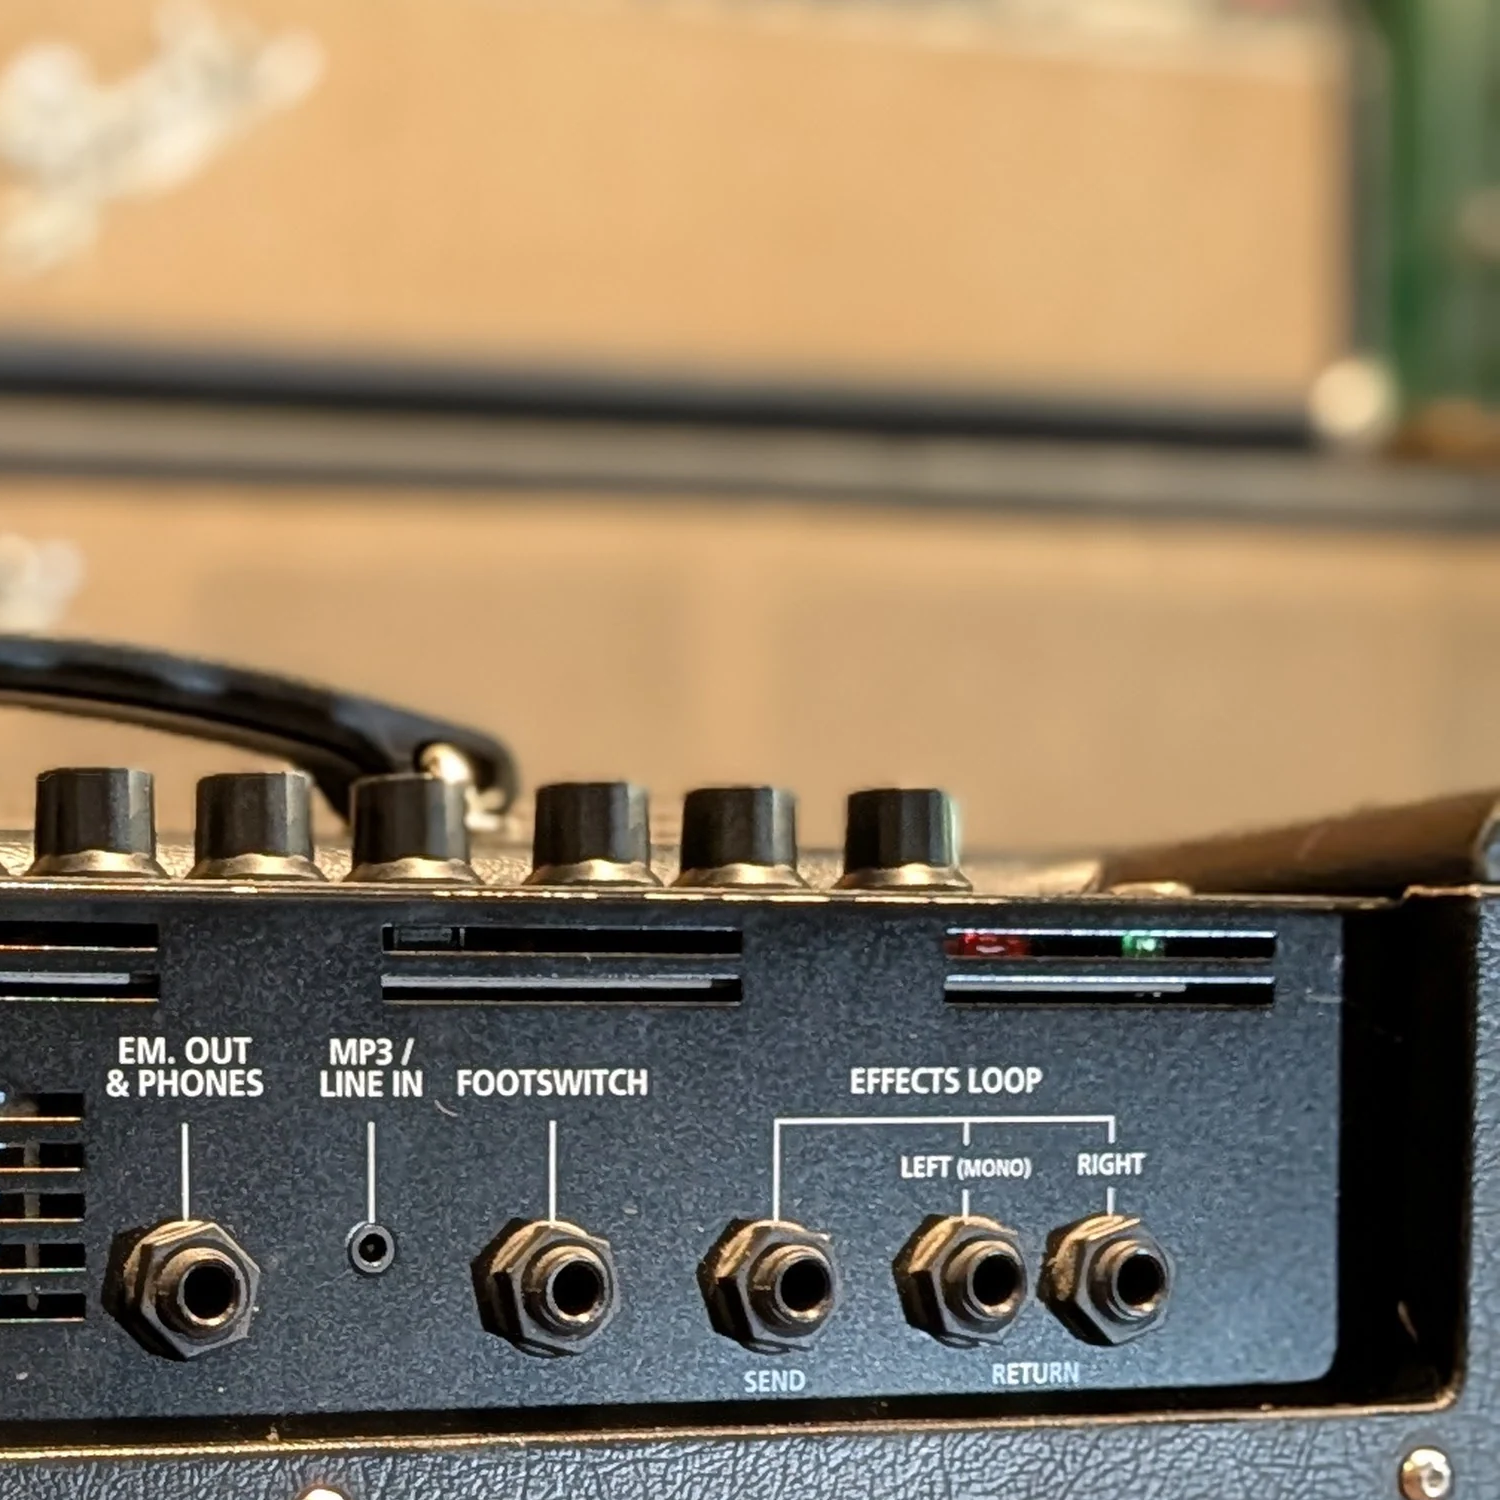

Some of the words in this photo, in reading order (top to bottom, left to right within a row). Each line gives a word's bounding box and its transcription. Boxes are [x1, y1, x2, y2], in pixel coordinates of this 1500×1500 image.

[117, 1037, 175, 1064] EM.
[185, 1036, 252, 1064] OUT
[329, 1038, 393, 1064] MP3
[402, 1037, 415, 1064] /
[105, 1071, 129, 1097] &
[138, 1069, 264, 1097] PHONES
[320, 1070, 383, 1098] LINE
[392, 1069, 423, 1097] IN
[456, 1069, 649, 1097] FOOTSWITCH
[850, 1067, 960, 1095] EFFECTS
[967, 1067, 1043, 1094] LOOP
[900, 1155, 952, 1179] LEFT
[956, 1157, 1032, 1180] (MONO)
[1077, 1153, 1146, 1176] RIGHT
[744, 1370, 806, 1393] SEND
[992, 1362, 1080, 1385] RETURN
